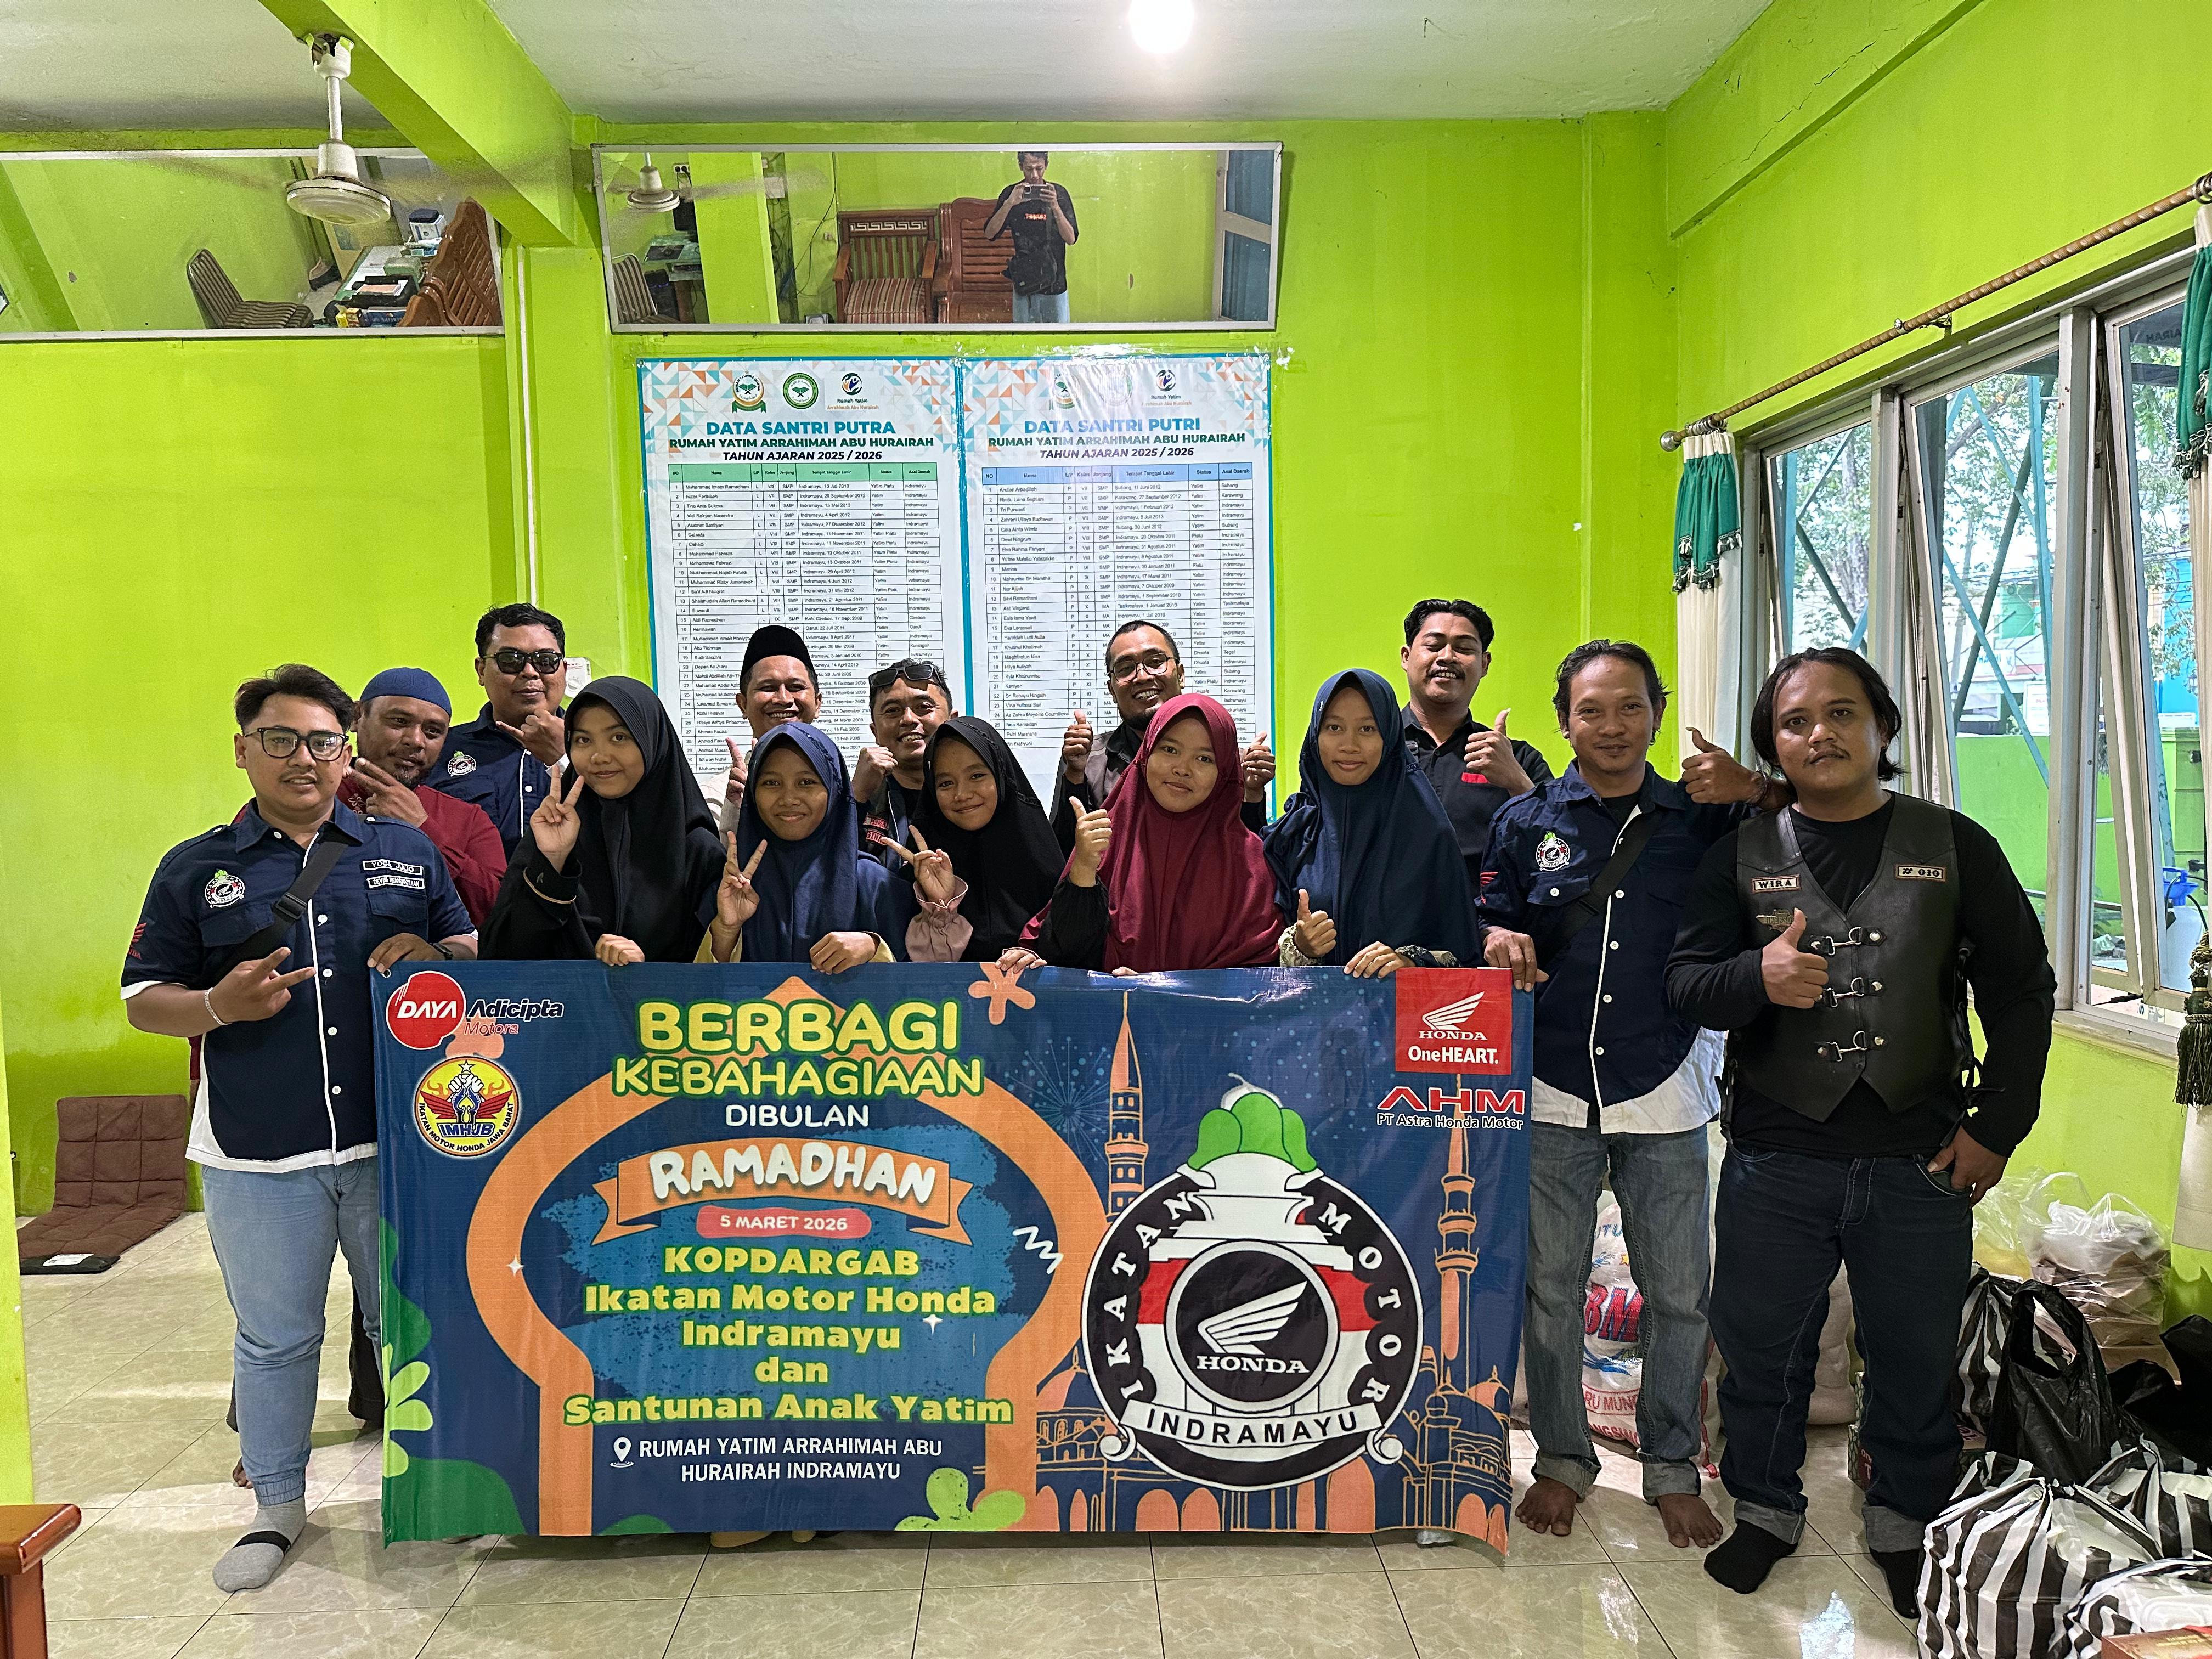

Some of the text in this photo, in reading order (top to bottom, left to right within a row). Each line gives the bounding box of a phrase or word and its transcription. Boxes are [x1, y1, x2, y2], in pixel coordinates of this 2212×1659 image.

[707, 421, 896, 435] DATA SANTRI PUTRA
[1025, 418, 1200, 433] DATA SANTRI PUTRI
[670, 438, 933, 448] RUMAH YATIM ARRAHIMAH ABU HURAIRAH
[989, 433, 1245, 447] RUMAH YATIM ARRAHIMAH ABU HURAIRAH
[766, 451, 815, 460] AJARAN
[818, 451, 844, 459] 2025
[847, 450, 853, 460] /
[855, 451, 882, 459] 2026
[1040, 447, 1194, 459] TAHUN AJARAN 2025 / 2026
[1758, 879, 1792, 888] WIRA
[397, 1000, 457, 1019] DAYA
[466, 999, 564, 1021] Adicipta
[464, 1022, 519, 1035] Motora
[638, 1000, 959, 1054] BERBAGI
[1419, 1030, 1488, 1040] HONDA
[615, 1057, 982, 1096] KEBAHAGIAAN
[1378, 1086, 1525, 1114] AHM
[419, 1103, 431, 1131] IKATAN
[429, 1130, 455, 1150] MOTOR
[487, 1128, 505, 1146] JAWA
[503, 1102, 513, 1127] BARAT
[725, 1104, 870, 1128] DIBULAN
[1377, 1113, 1523, 1129] PT Astra Honda Motor
[439, 1124, 494, 1137] IMHJB
[648, 1142, 936, 1203] RAMADHAN
[720, 1215, 848, 1231] 5 MARET 2026
[664, 1247, 919, 1275] KOPDARGAB
[585, 1284, 996, 1315] Ikatan Motor Honda
[1103, 1191, 1402, 1403] IKATAN MOTOR
[682, 1319, 900, 1354] Indramayu
[755, 1357, 828, 1384] dan
[1197, 1355, 1310, 1373] HONDA
[563, 1395, 1014, 1425] Santunan Anak Yatim
[1147, 1409, 1357, 1444] INDRAMAYU
[639, 1437, 943, 1458] RUMAH YATIM ARRAHIMAH ABU
[681, 1462, 901, 1483] HURAIRAH INDRAMAYU
